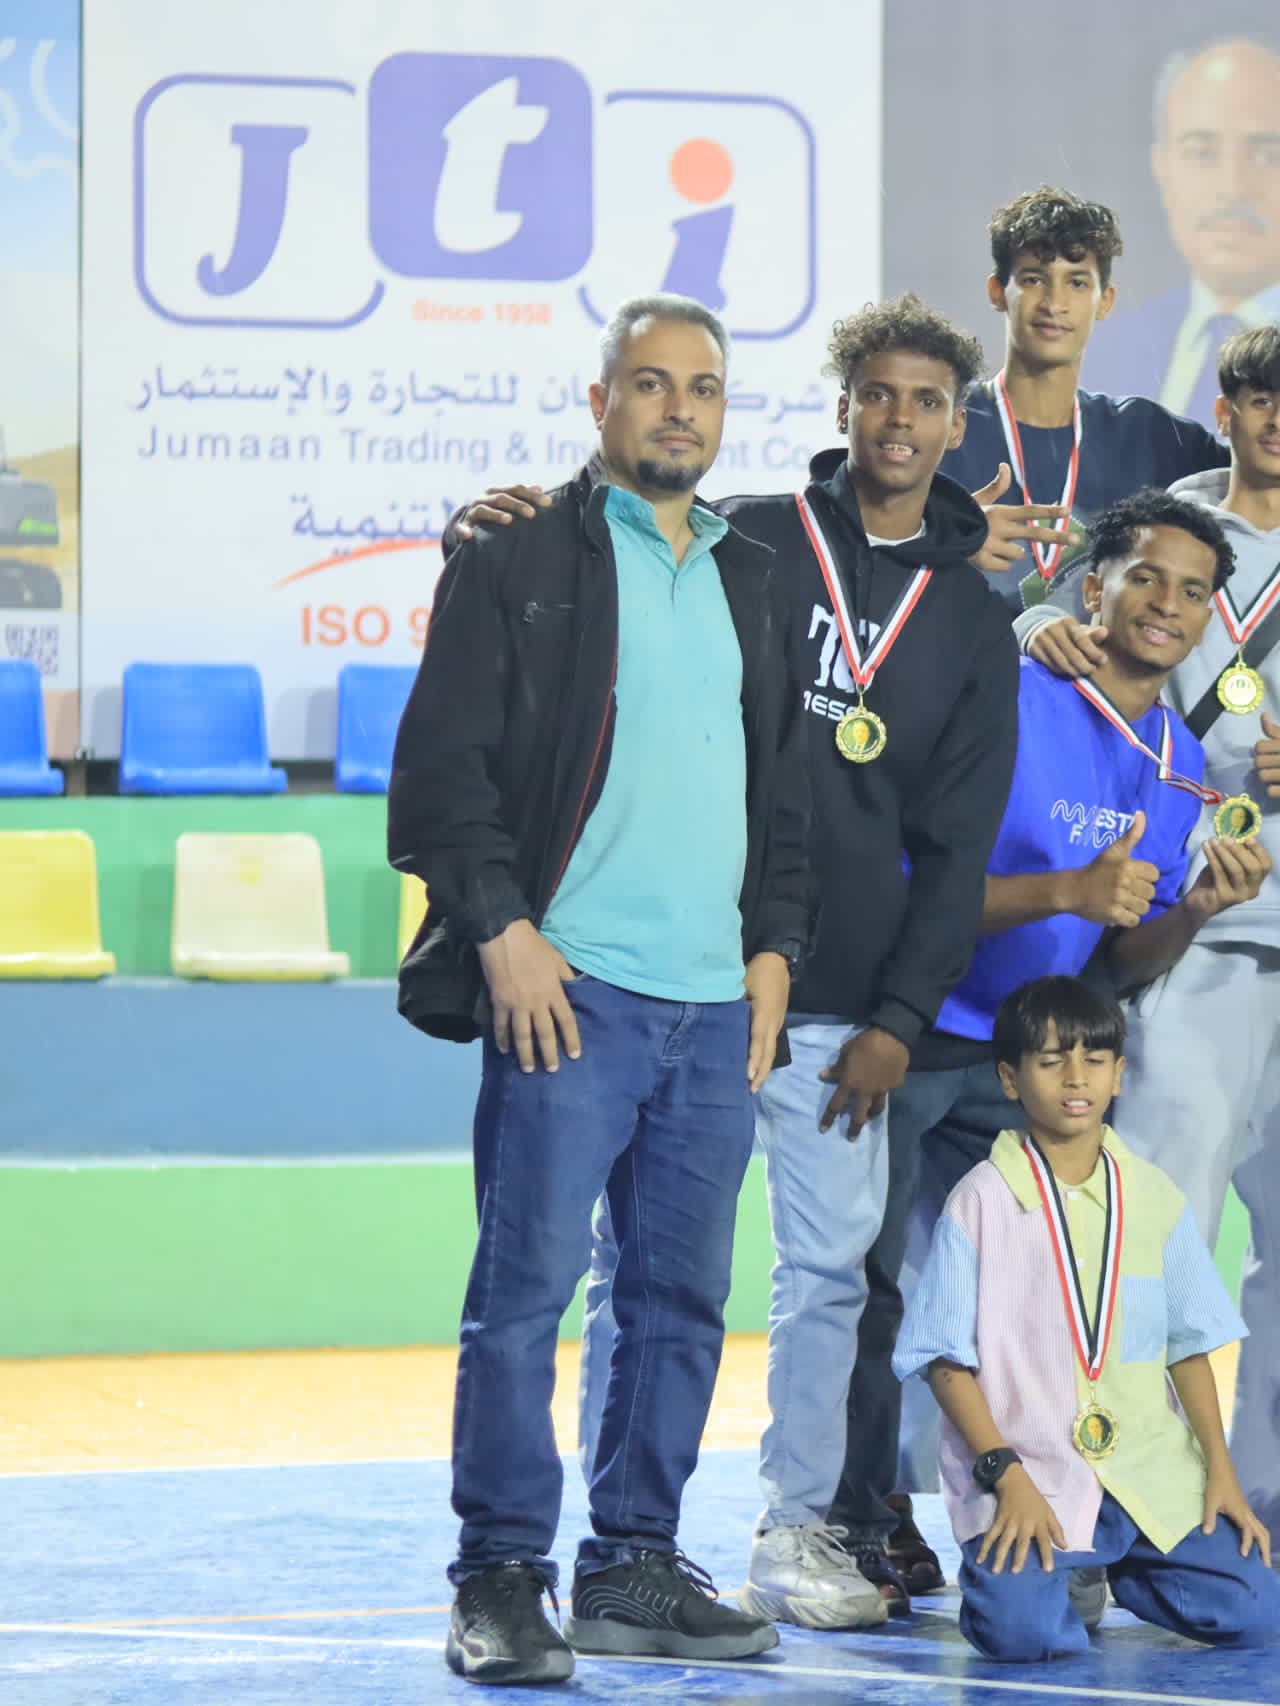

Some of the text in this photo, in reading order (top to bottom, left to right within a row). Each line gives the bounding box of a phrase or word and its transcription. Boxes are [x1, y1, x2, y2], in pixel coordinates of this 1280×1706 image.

[366, 368, 519, 416] للتجارة
[725, 382, 827, 424] شرك
[138, 424, 321, 461] Jumaan
[341, 427, 488, 473] Trading
[505, 432, 531, 466] &
[300, 603, 391, 649] ISO
